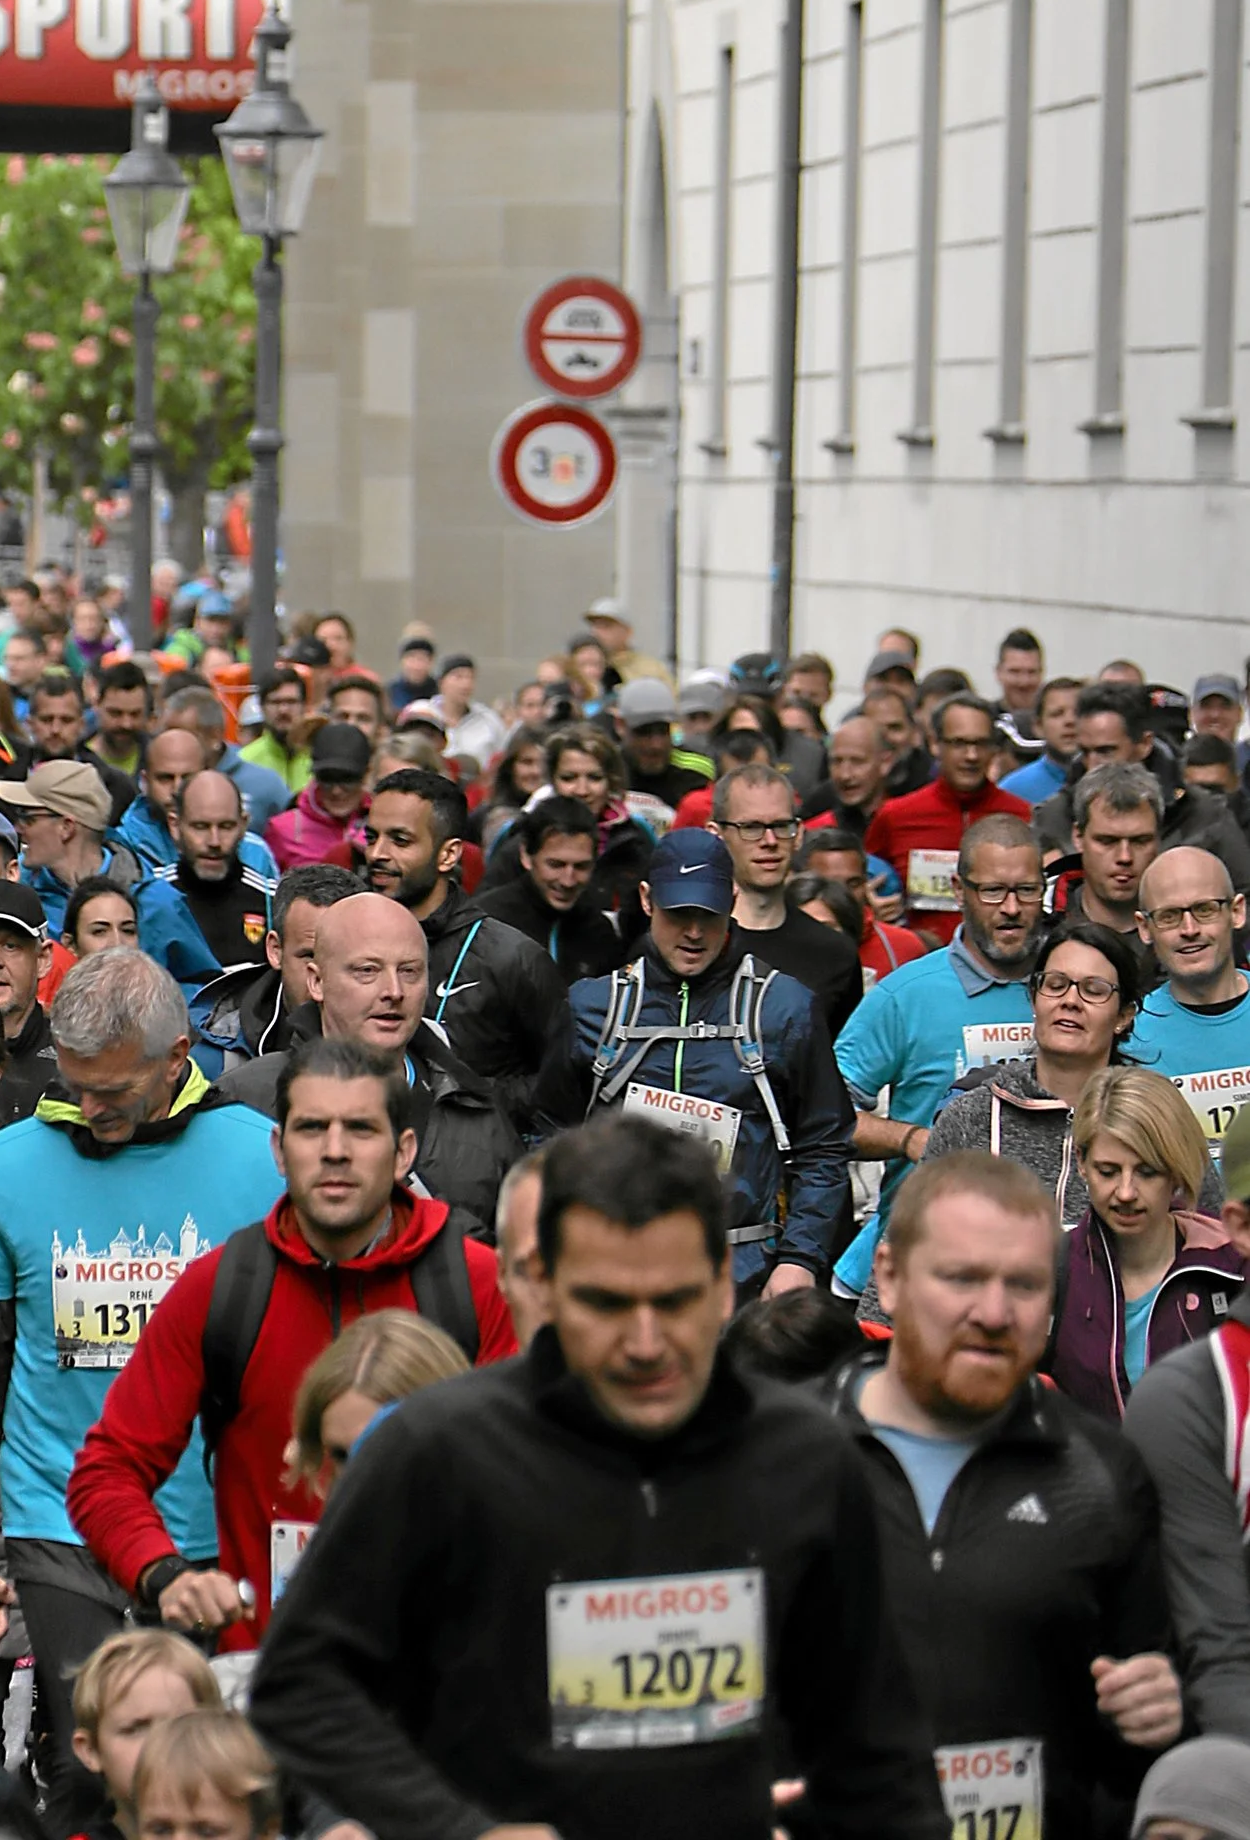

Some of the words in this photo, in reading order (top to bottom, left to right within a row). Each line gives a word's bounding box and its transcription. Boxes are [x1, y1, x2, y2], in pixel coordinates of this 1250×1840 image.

[113, 68, 258, 101] MGROS
[1191, 1069, 1250, 1093] MIGR
[643, 1090, 724, 1122] MIGROS
[75, 1261, 182, 1282] MIGROS
[130, 1289, 153, 1300] RENÉ
[73, 1321, 81, 1338] 3
[94, 1303, 159, 1337] 131
[585, 1583, 730, 1622] MIGROS
[612, 1644, 744, 1700] 12072
